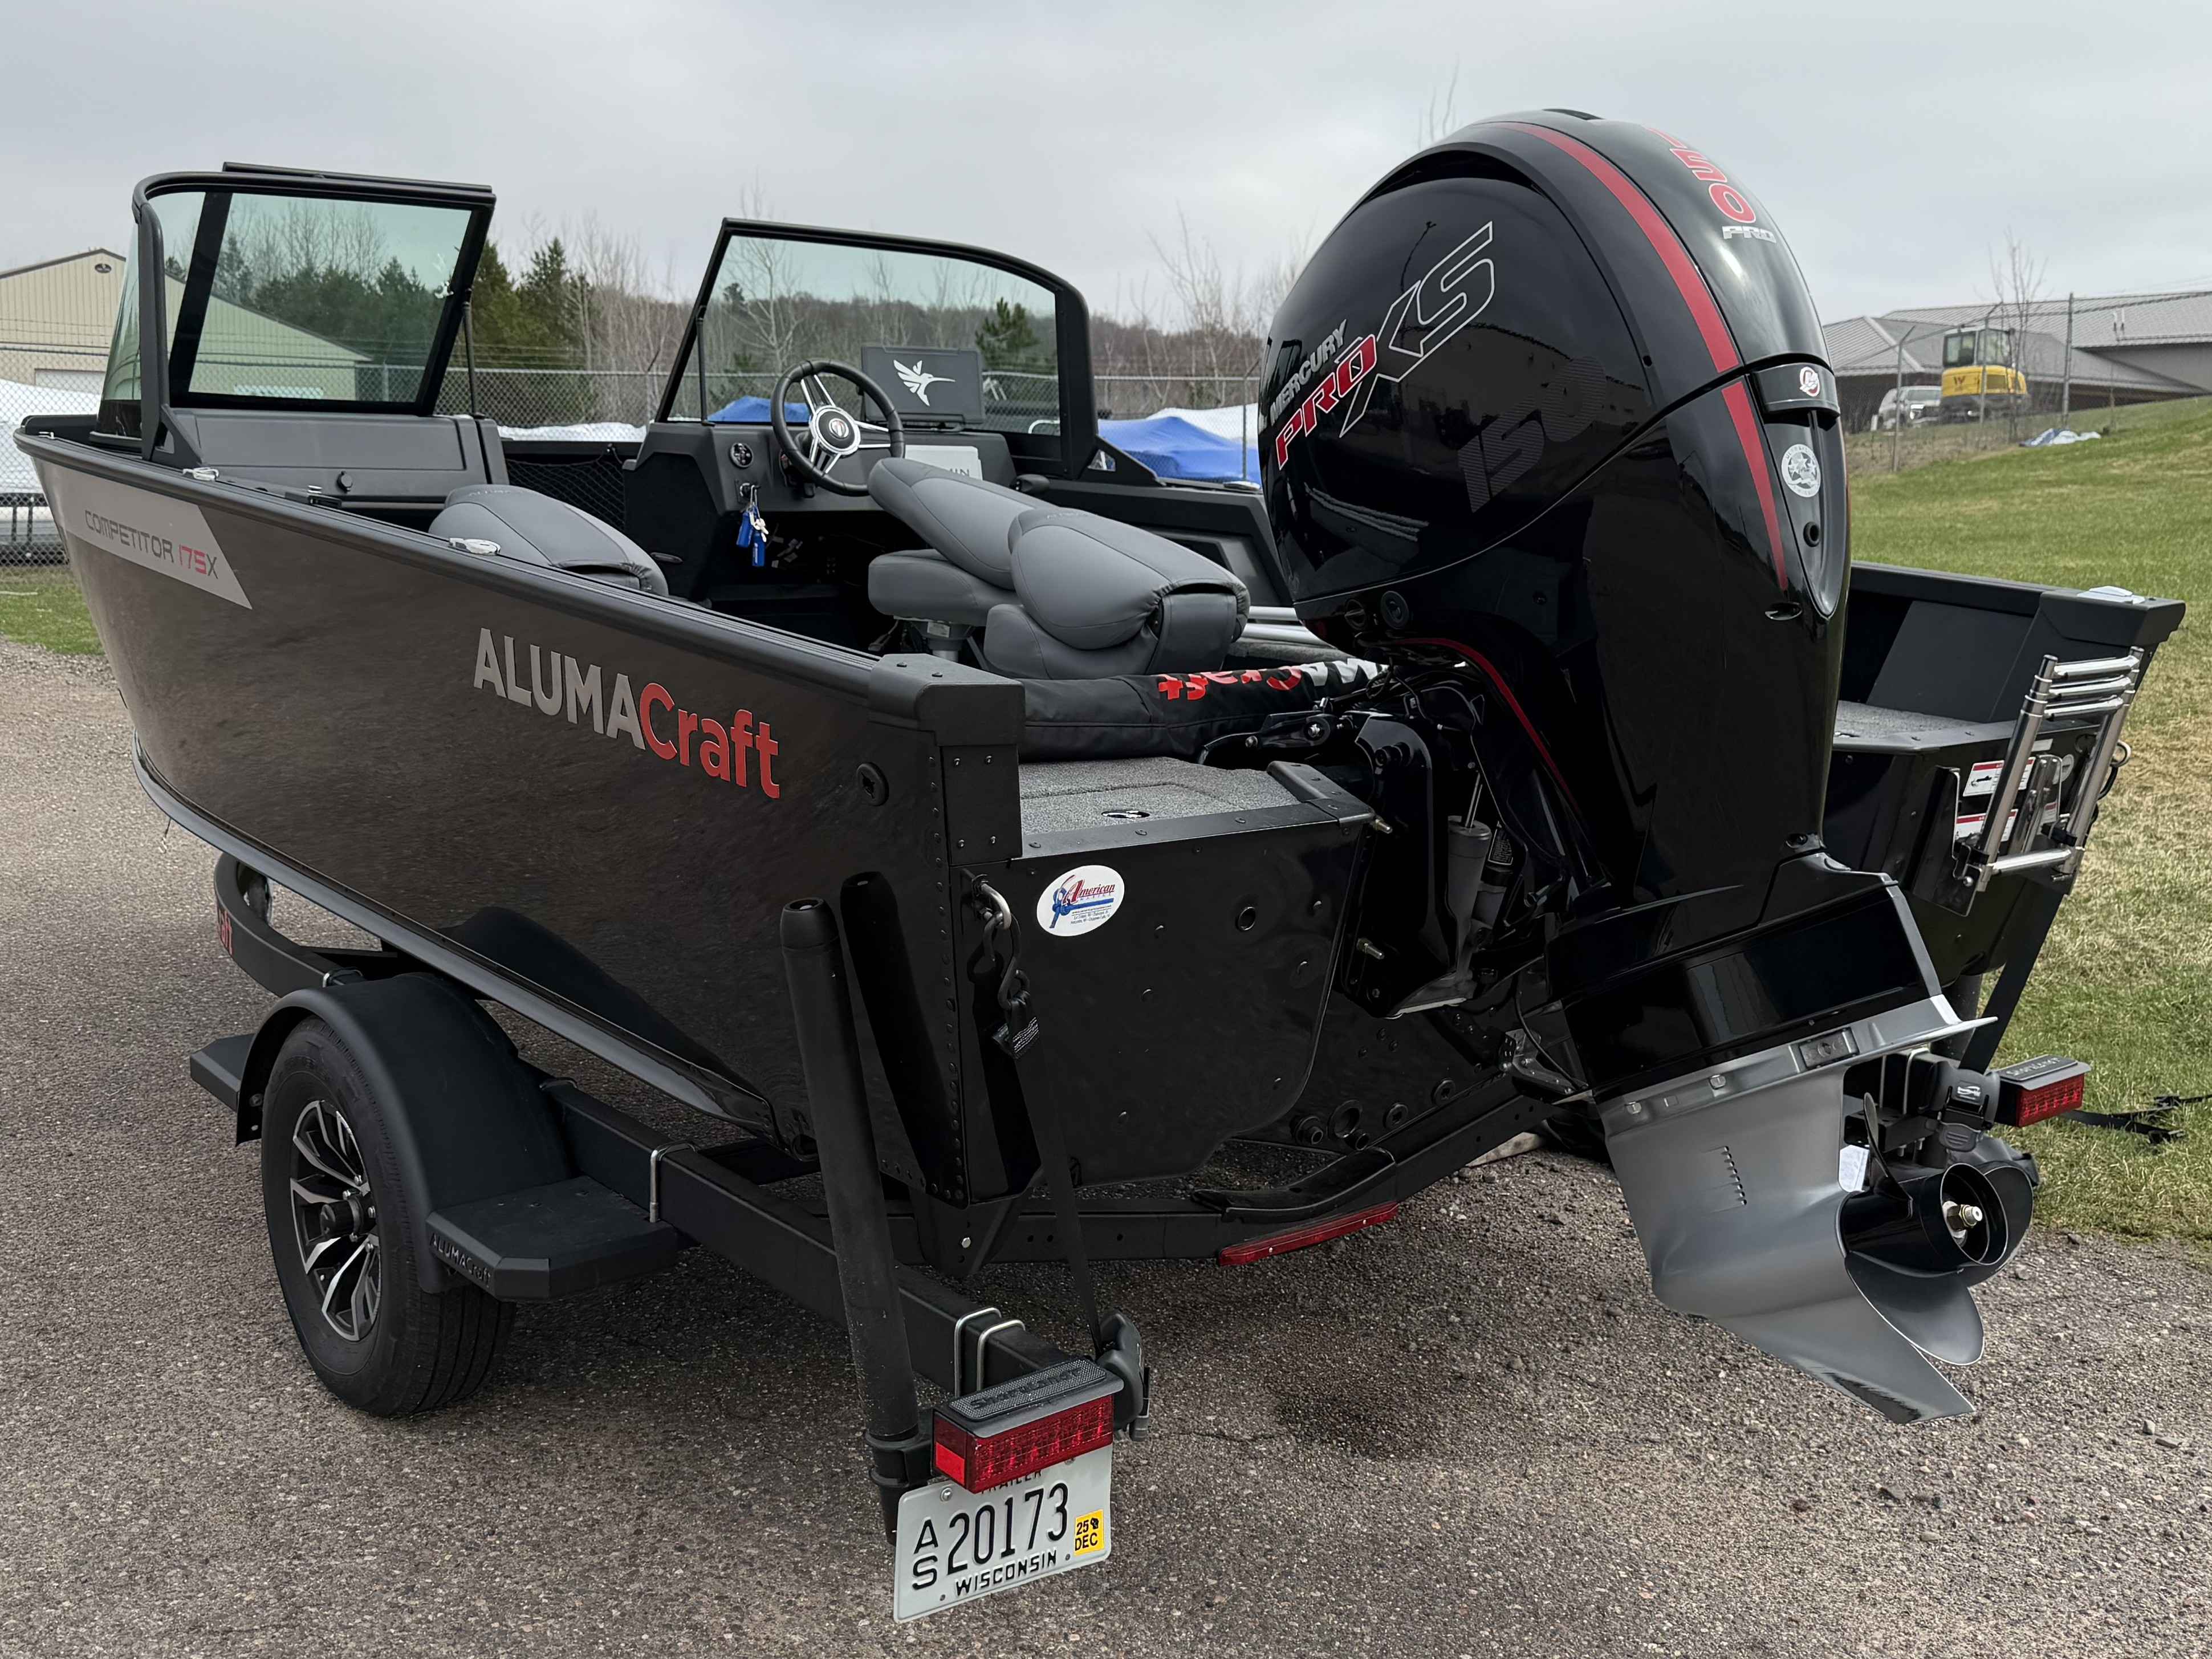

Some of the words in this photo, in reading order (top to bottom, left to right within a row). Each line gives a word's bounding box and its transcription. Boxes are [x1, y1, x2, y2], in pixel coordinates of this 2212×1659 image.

[1722, 226, 1776, 243] PRO
[1270, 319, 1347, 426] MERCURY
[1275, 334, 1377, 470] PRO
[1457, 356, 1606, 514] 150
[85, 510, 174, 563] COMPETITOR
[178, 544, 219, 579] 175X
[473, 627, 780, 799] ALUMACraft
[1063, 879, 1116, 905] American
[947, 1482, 1069, 1575] 20173
[1075, 1532, 1098, 1551] DEC
[1076, 1519, 1089, 1536] 25
[955, 1549, 1057, 1596] WISCONSIN
